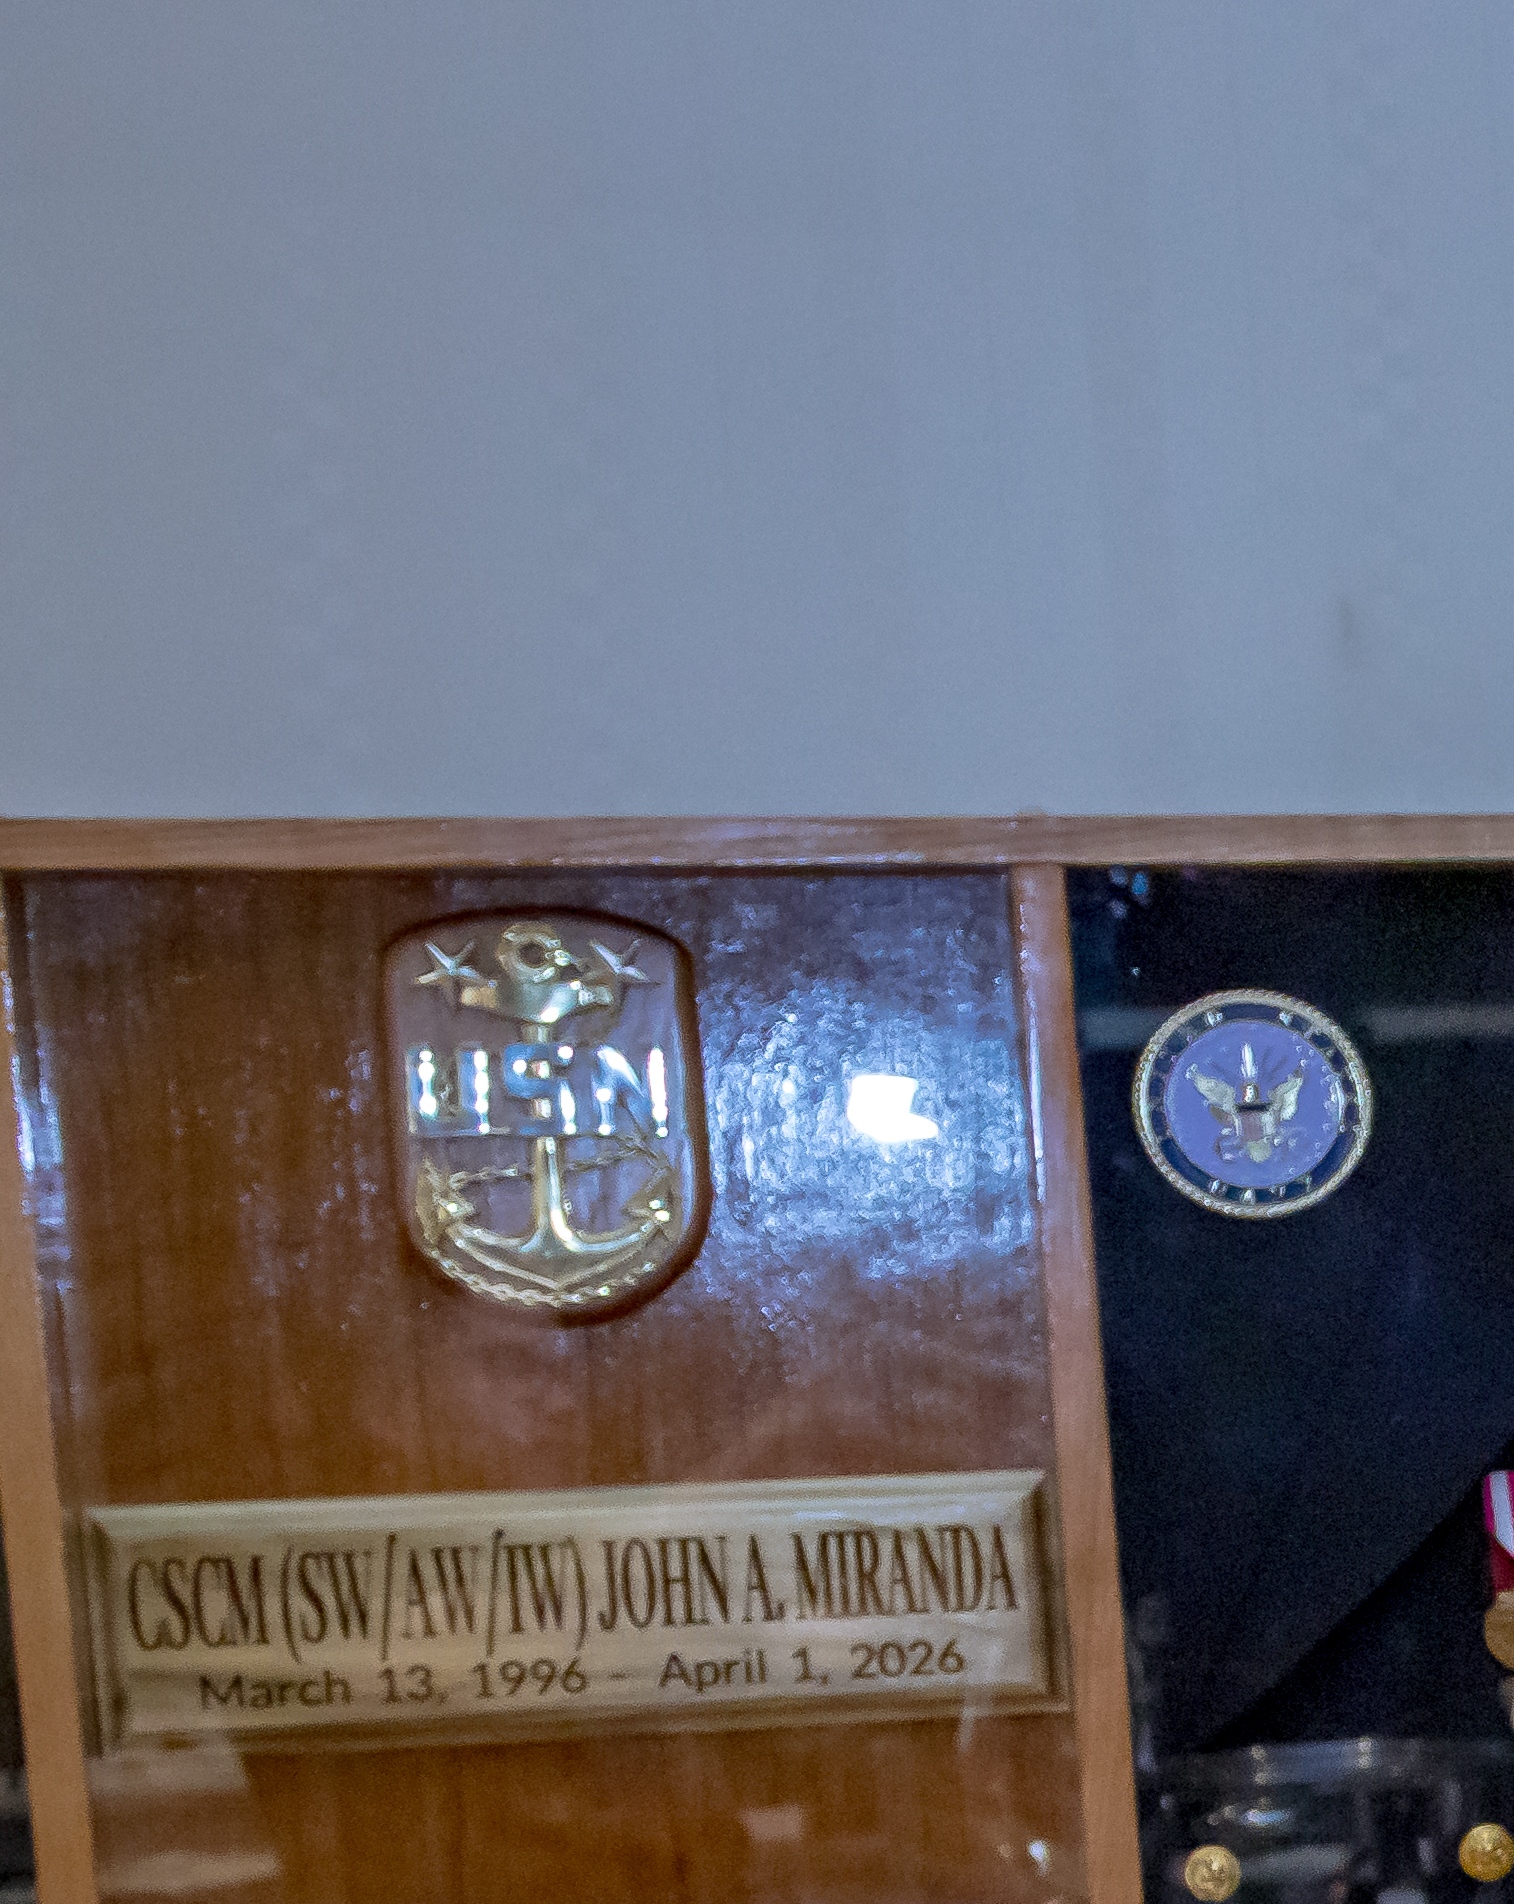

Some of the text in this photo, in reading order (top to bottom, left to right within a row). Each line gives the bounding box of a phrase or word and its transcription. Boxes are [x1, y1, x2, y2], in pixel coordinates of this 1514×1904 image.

[404, 1043, 671, 1138] USN
[126, 1553, 271, 1652] CSCM
[280, 1529, 588, 1665] (SW/AW/IW)
[598, 1533, 732, 1631] JOHN
[792, 1522, 1019, 1620] MIRANDA
[200, 1668, 353, 1712] March
[378, 1660, 447, 1705] 13,
[470, 1656, 588, 1702] 1996
[657, 1648, 768, 1694] April
[792, 1644, 830, 1688] 1,
[850, 1637, 967, 1682] 2026
